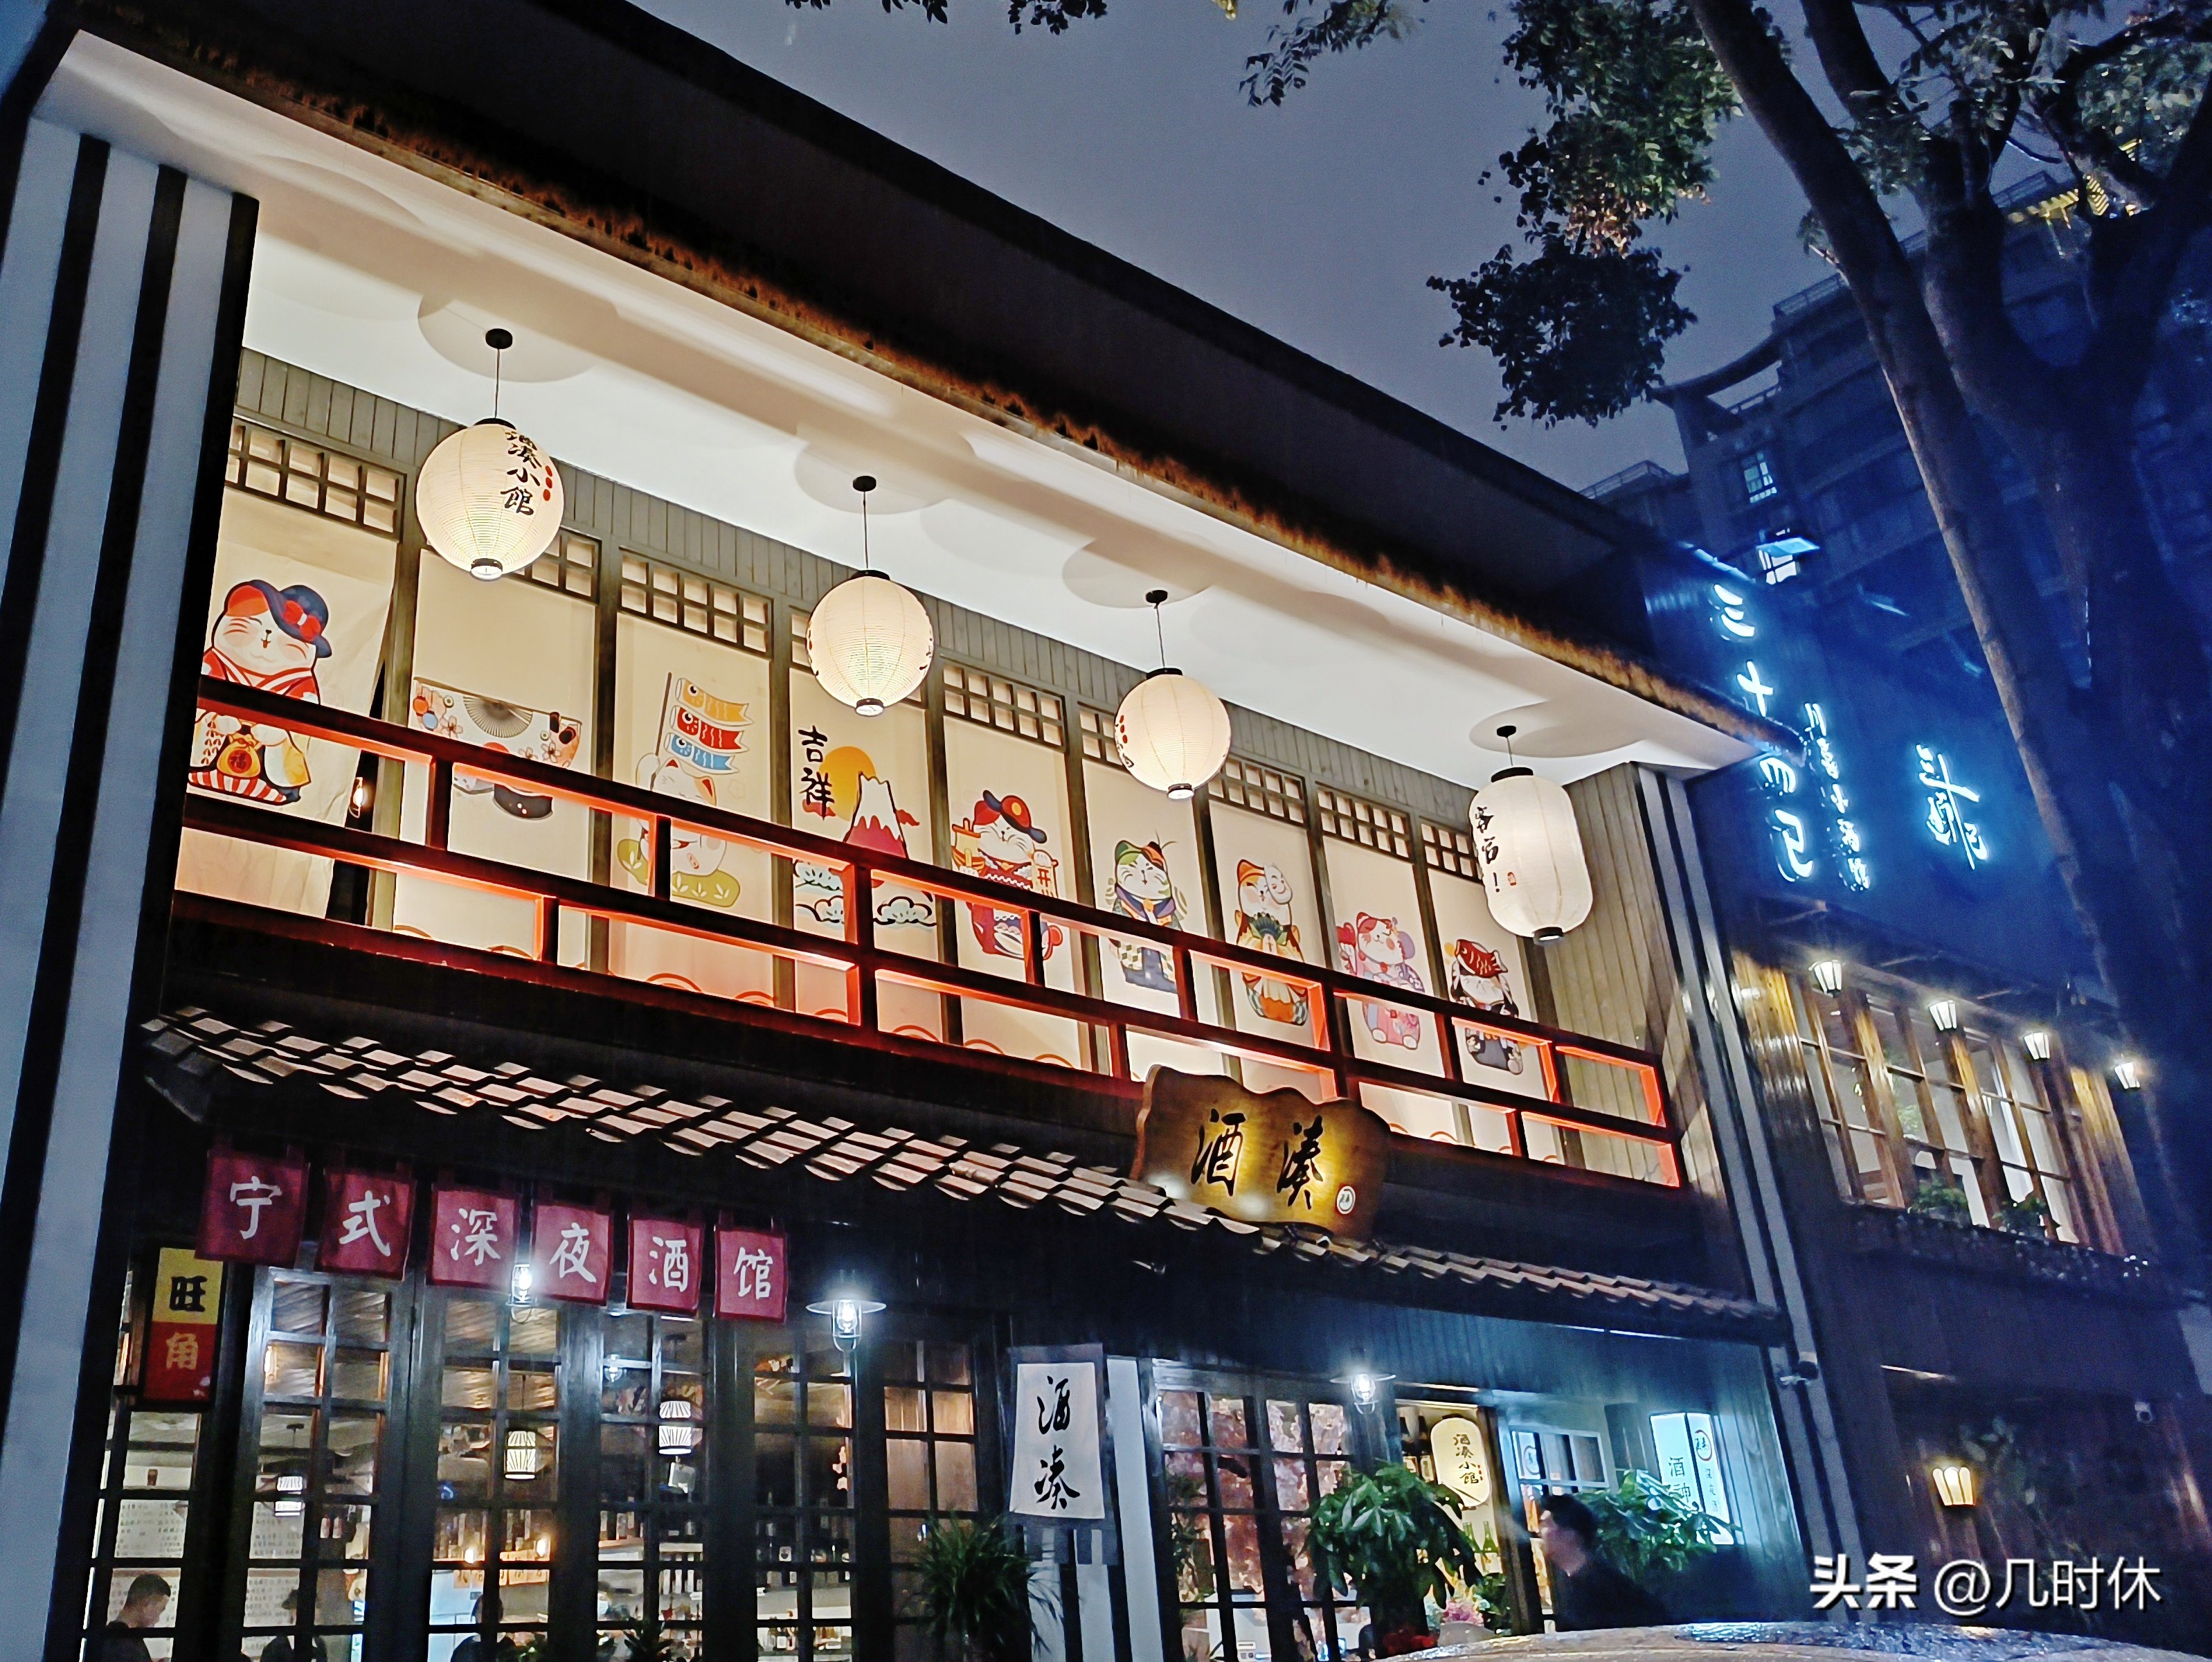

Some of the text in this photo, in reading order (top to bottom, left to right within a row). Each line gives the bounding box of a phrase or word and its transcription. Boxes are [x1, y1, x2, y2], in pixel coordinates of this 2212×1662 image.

[798, 725, 834, 821] 吉祥
[229, 1176, 773, 1301] 宁式深夜酒馆
[165, 1274, 208, 1370] 旺角
